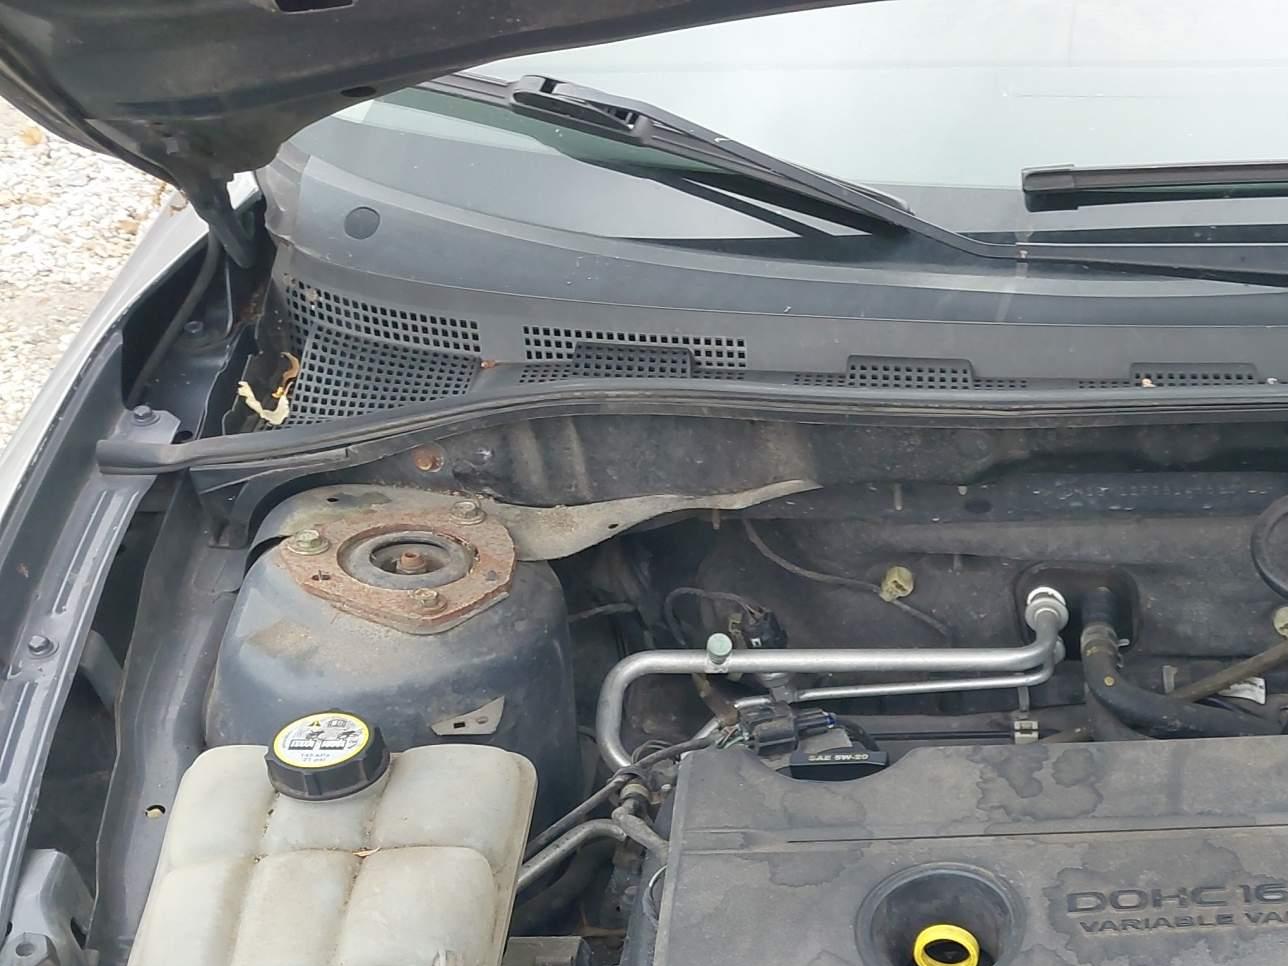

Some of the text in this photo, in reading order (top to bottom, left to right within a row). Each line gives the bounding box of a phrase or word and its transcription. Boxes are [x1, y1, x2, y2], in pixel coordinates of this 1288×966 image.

[834, 753, 870, 761] 5W-20
[1066, 886, 1229, 913] DOHC
[1079, 913, 1235, 932] VARIABLE
